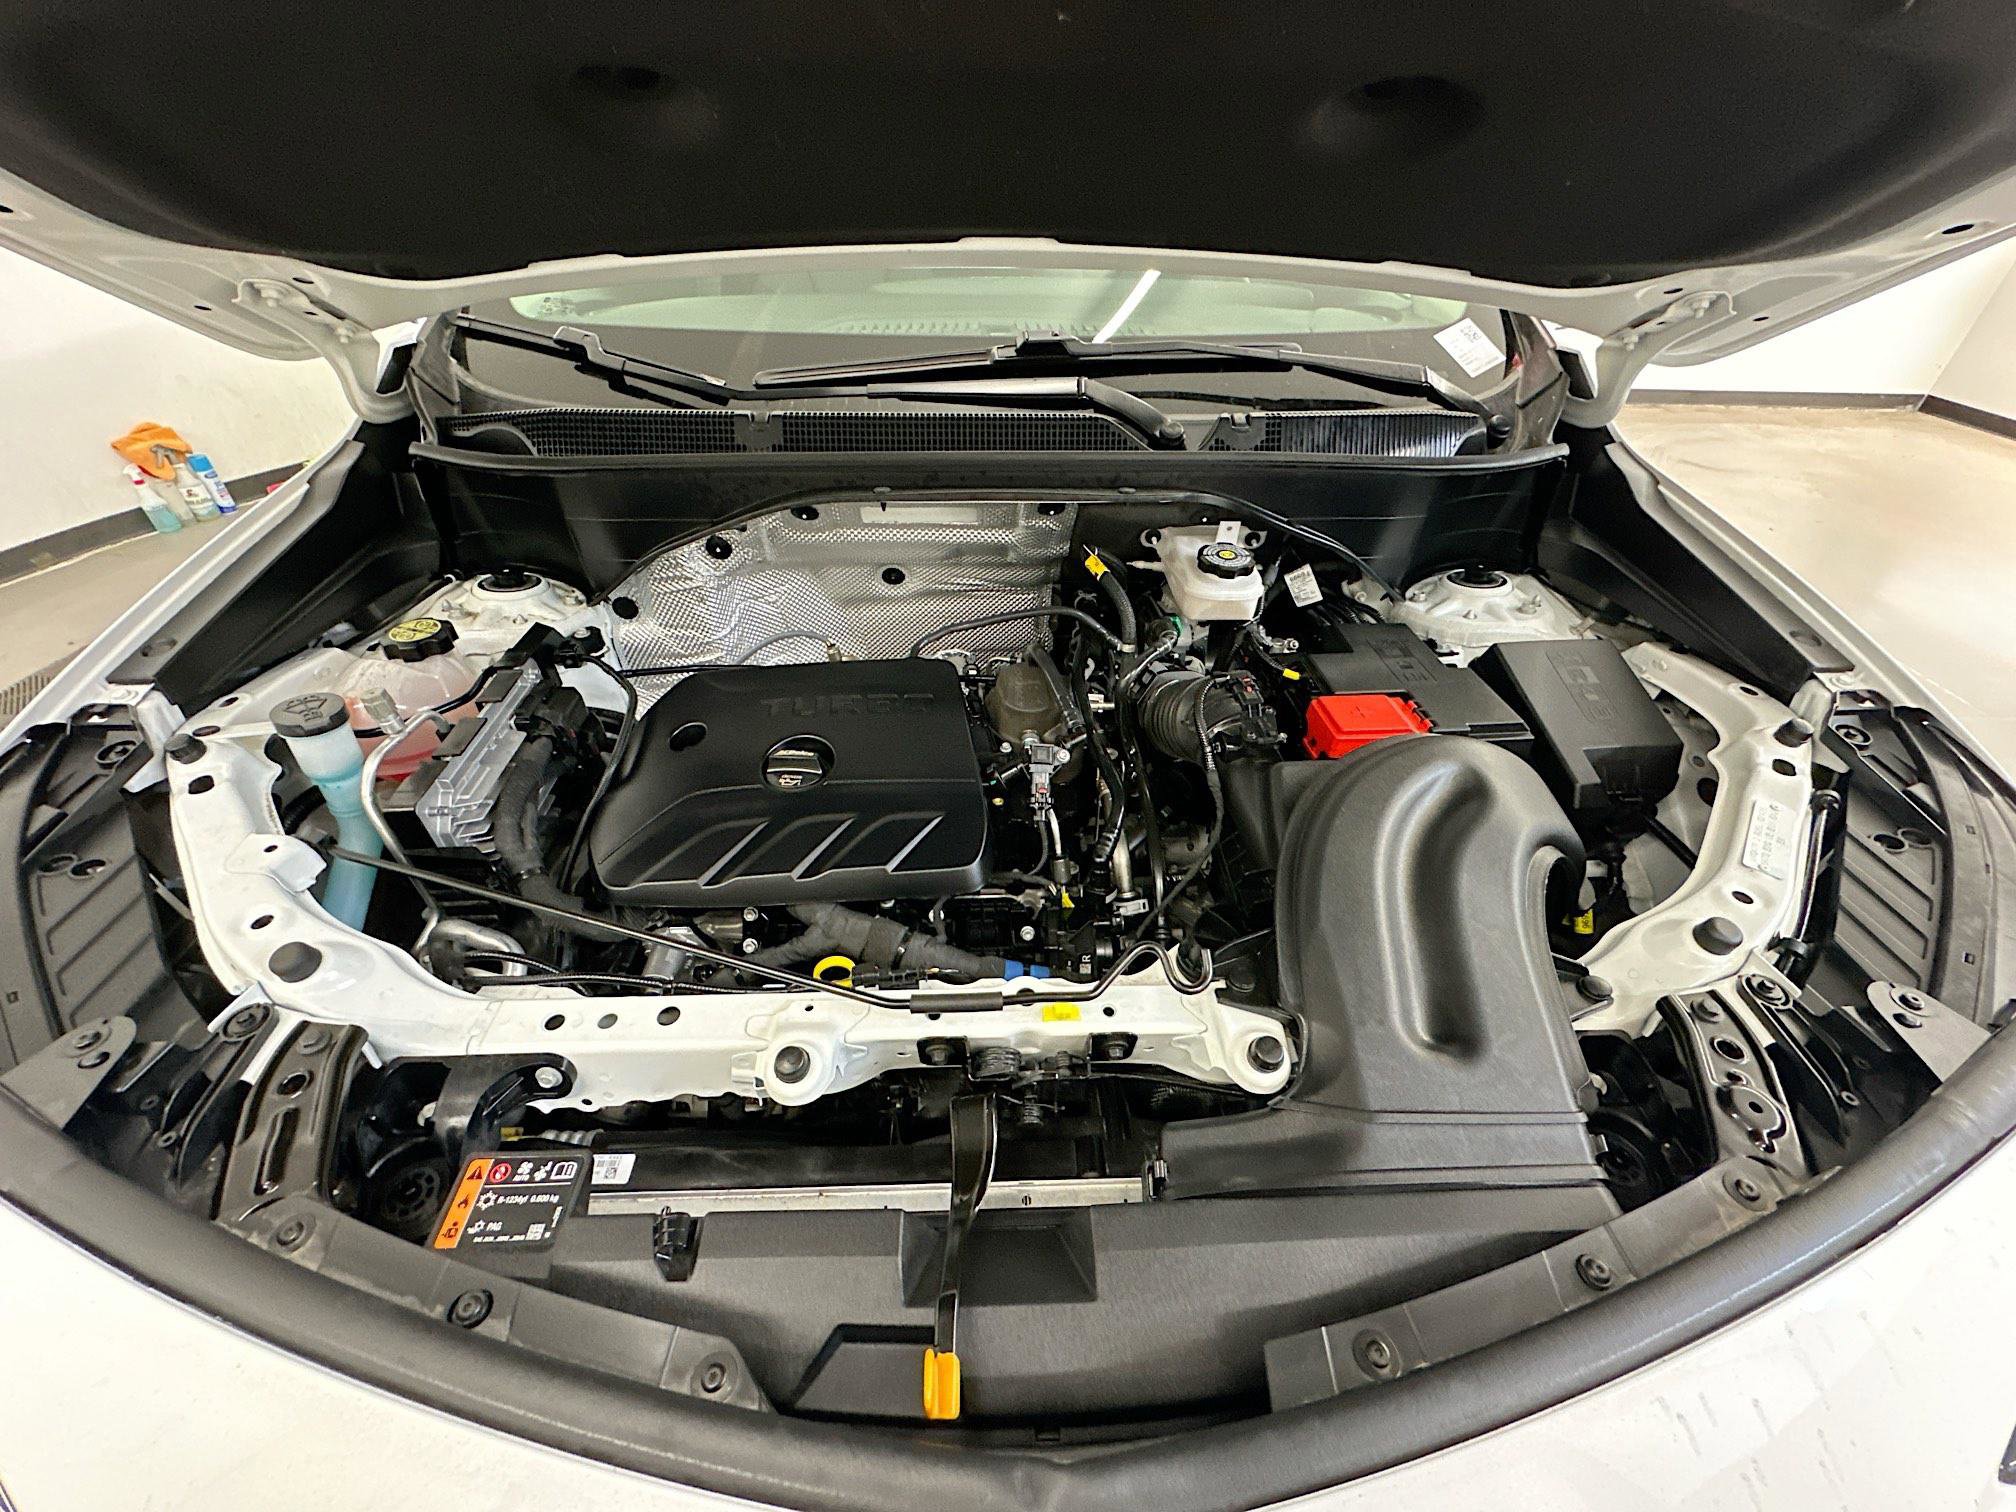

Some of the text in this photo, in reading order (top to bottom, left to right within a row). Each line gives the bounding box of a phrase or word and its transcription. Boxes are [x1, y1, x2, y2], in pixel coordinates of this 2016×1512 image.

[1081, 954, 1091, 963] R
[512, 1174, 530, 1182] AUTO
[486, 1221, 503, 1231] PAG
